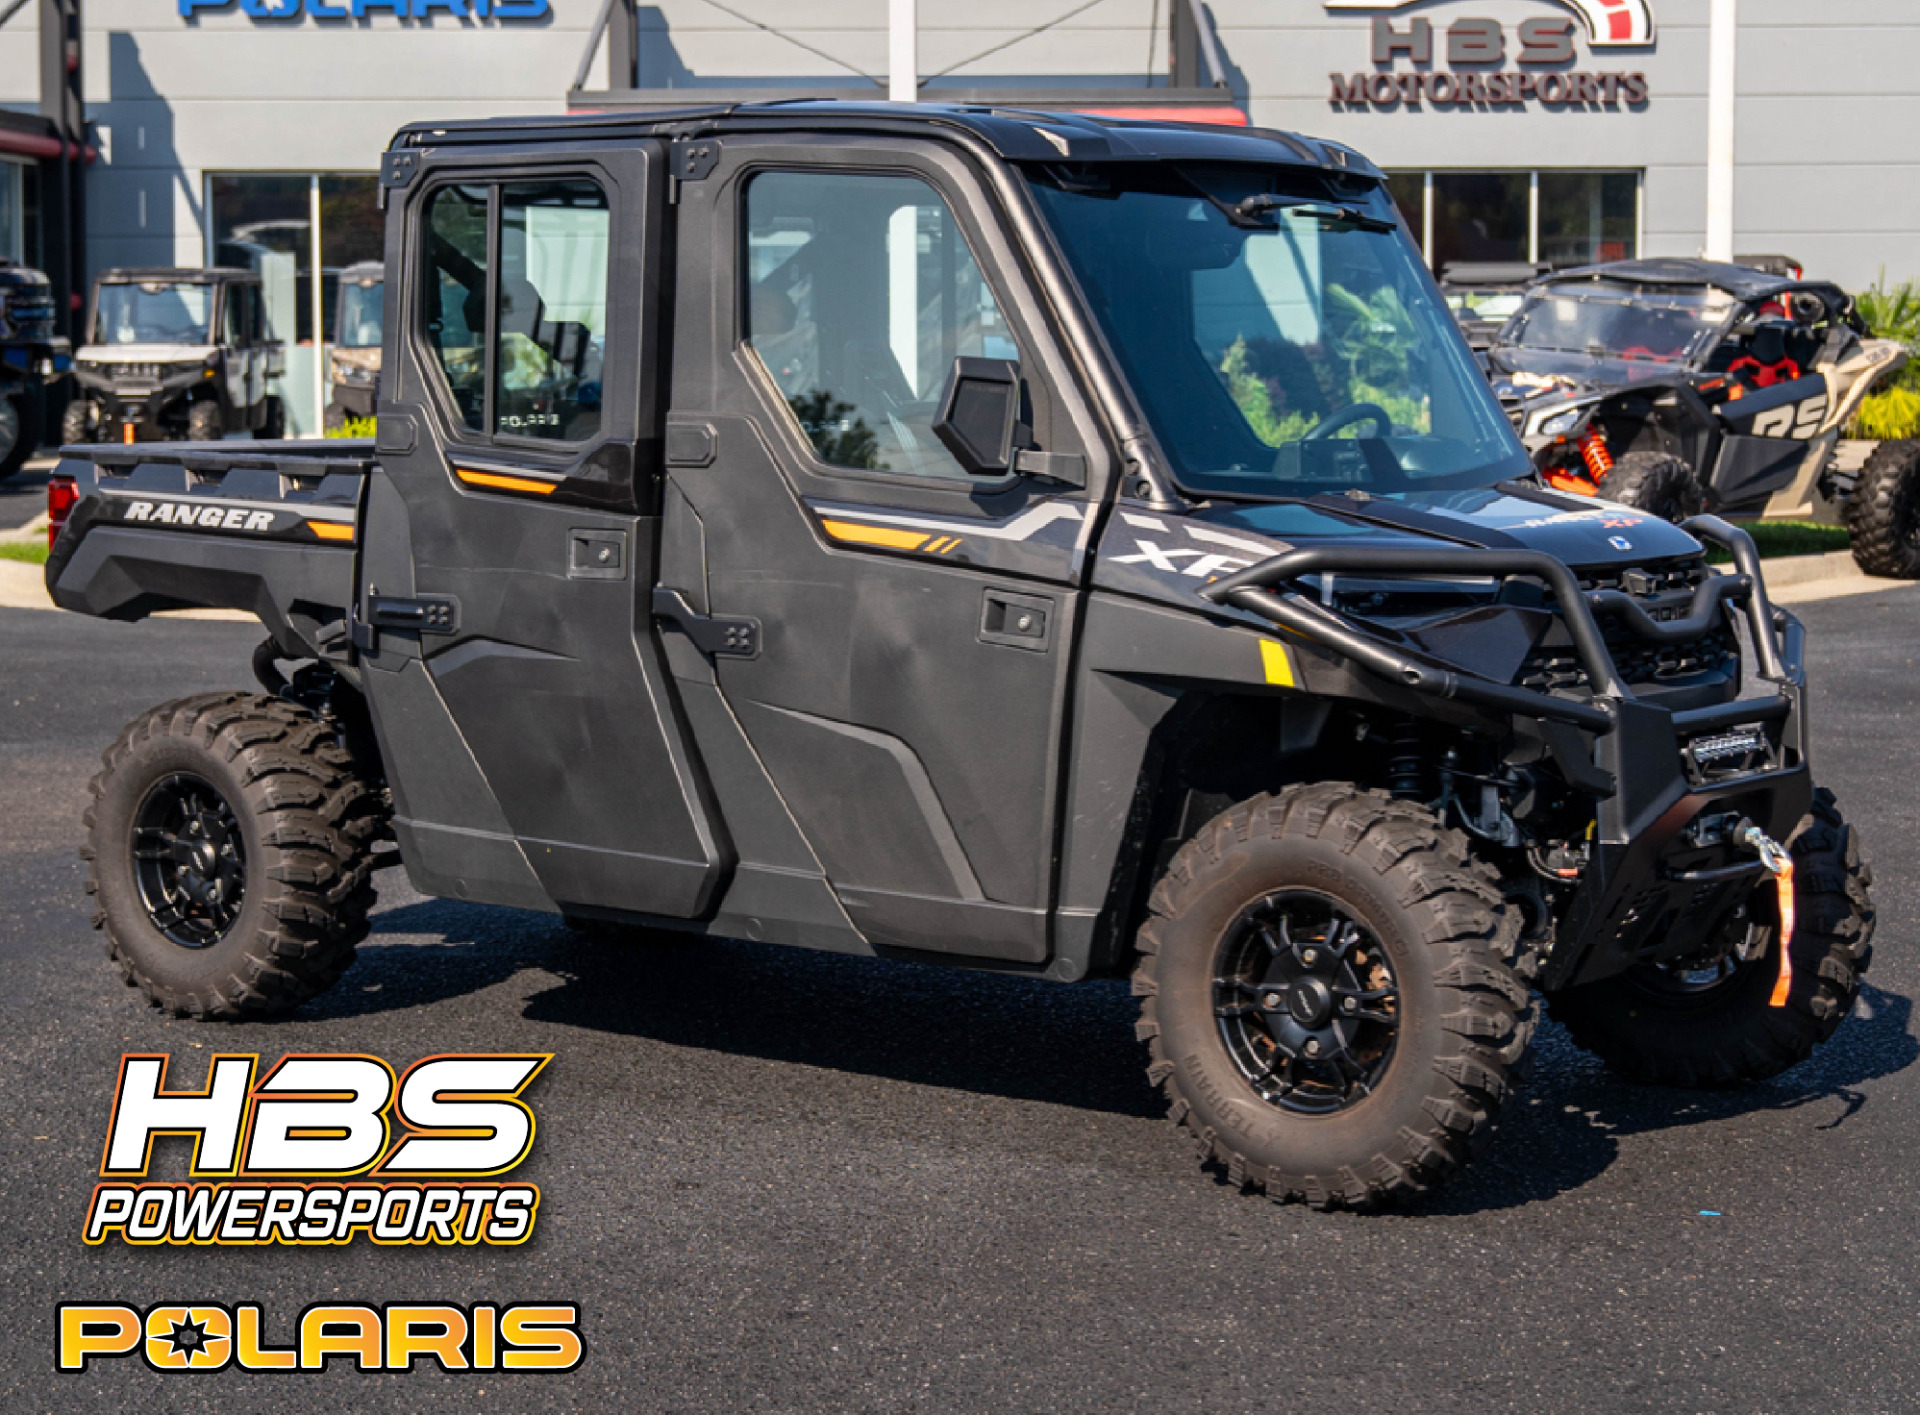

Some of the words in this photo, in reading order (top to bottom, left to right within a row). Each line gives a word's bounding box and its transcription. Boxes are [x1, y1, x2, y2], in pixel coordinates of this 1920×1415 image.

[1372, 17, 1575, 62] HBS
[1328, 73, 1648, 104] MOTORSPORTS
[124, 500, 276, 532] RANGER
